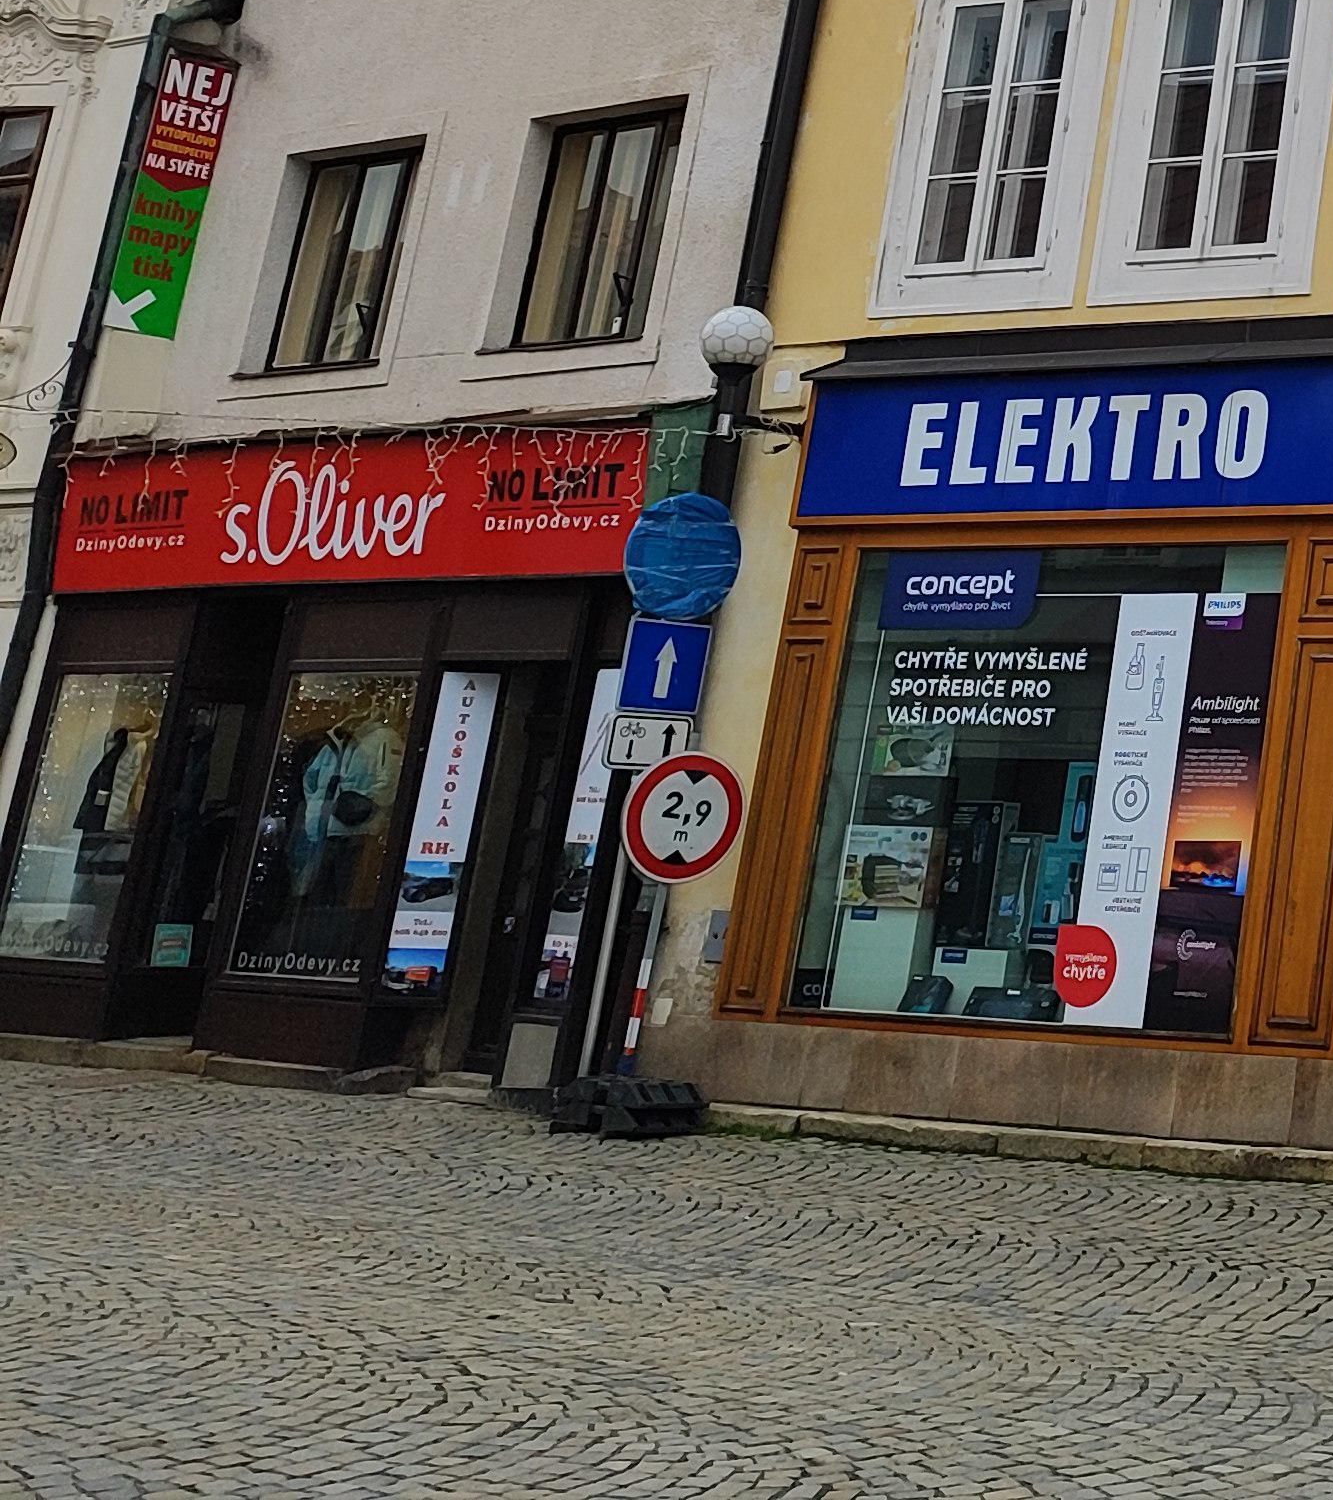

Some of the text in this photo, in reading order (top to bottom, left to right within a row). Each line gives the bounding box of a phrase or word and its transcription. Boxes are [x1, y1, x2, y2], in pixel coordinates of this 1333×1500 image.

[163, 58, 233, 107] NEJ
[160, 99, 224, 135] VĚTŠÍ
[145, 153, 166, 171] NA
[133, 191, 199, 231] knihy
[128, 224, 194, 258] mapy
[132, 255, 174, 283] tisk
[899, 389, 1269, 487] ELEKTRO
[489, 463, 625, 502] NO LIMIT
[79, 489, 189, 527] NO LIMIT
[220, 461, 447, 566] s.Oliver
[484, 512, 620, 533] DzinyOdevy.cz
[75, 534, 185, 553] DzinyOdevy.cz
[905, 569, 1016, 600] concept
[1207, 600, 1242, 610] PHILIPS
[894, 646, 1089, 671] CHYTŘE VYMYŠLENÉ
[889, 674, 1051, 698] SPOTŘEBIČE PRO
[886, 701, 1057, 728] VAŠI DOMÁCNOST
[1190, 695, 1259, 713] Ambilight
[436, 678, 477, 828] AUTOŠKOLA
[660, 791, 712, 827] 2,9
[672, 829, 689, 842] m
[237, 951, 362, 975] DzinyOdevy.cz
[1062, 963, 1107, 982] chytře
